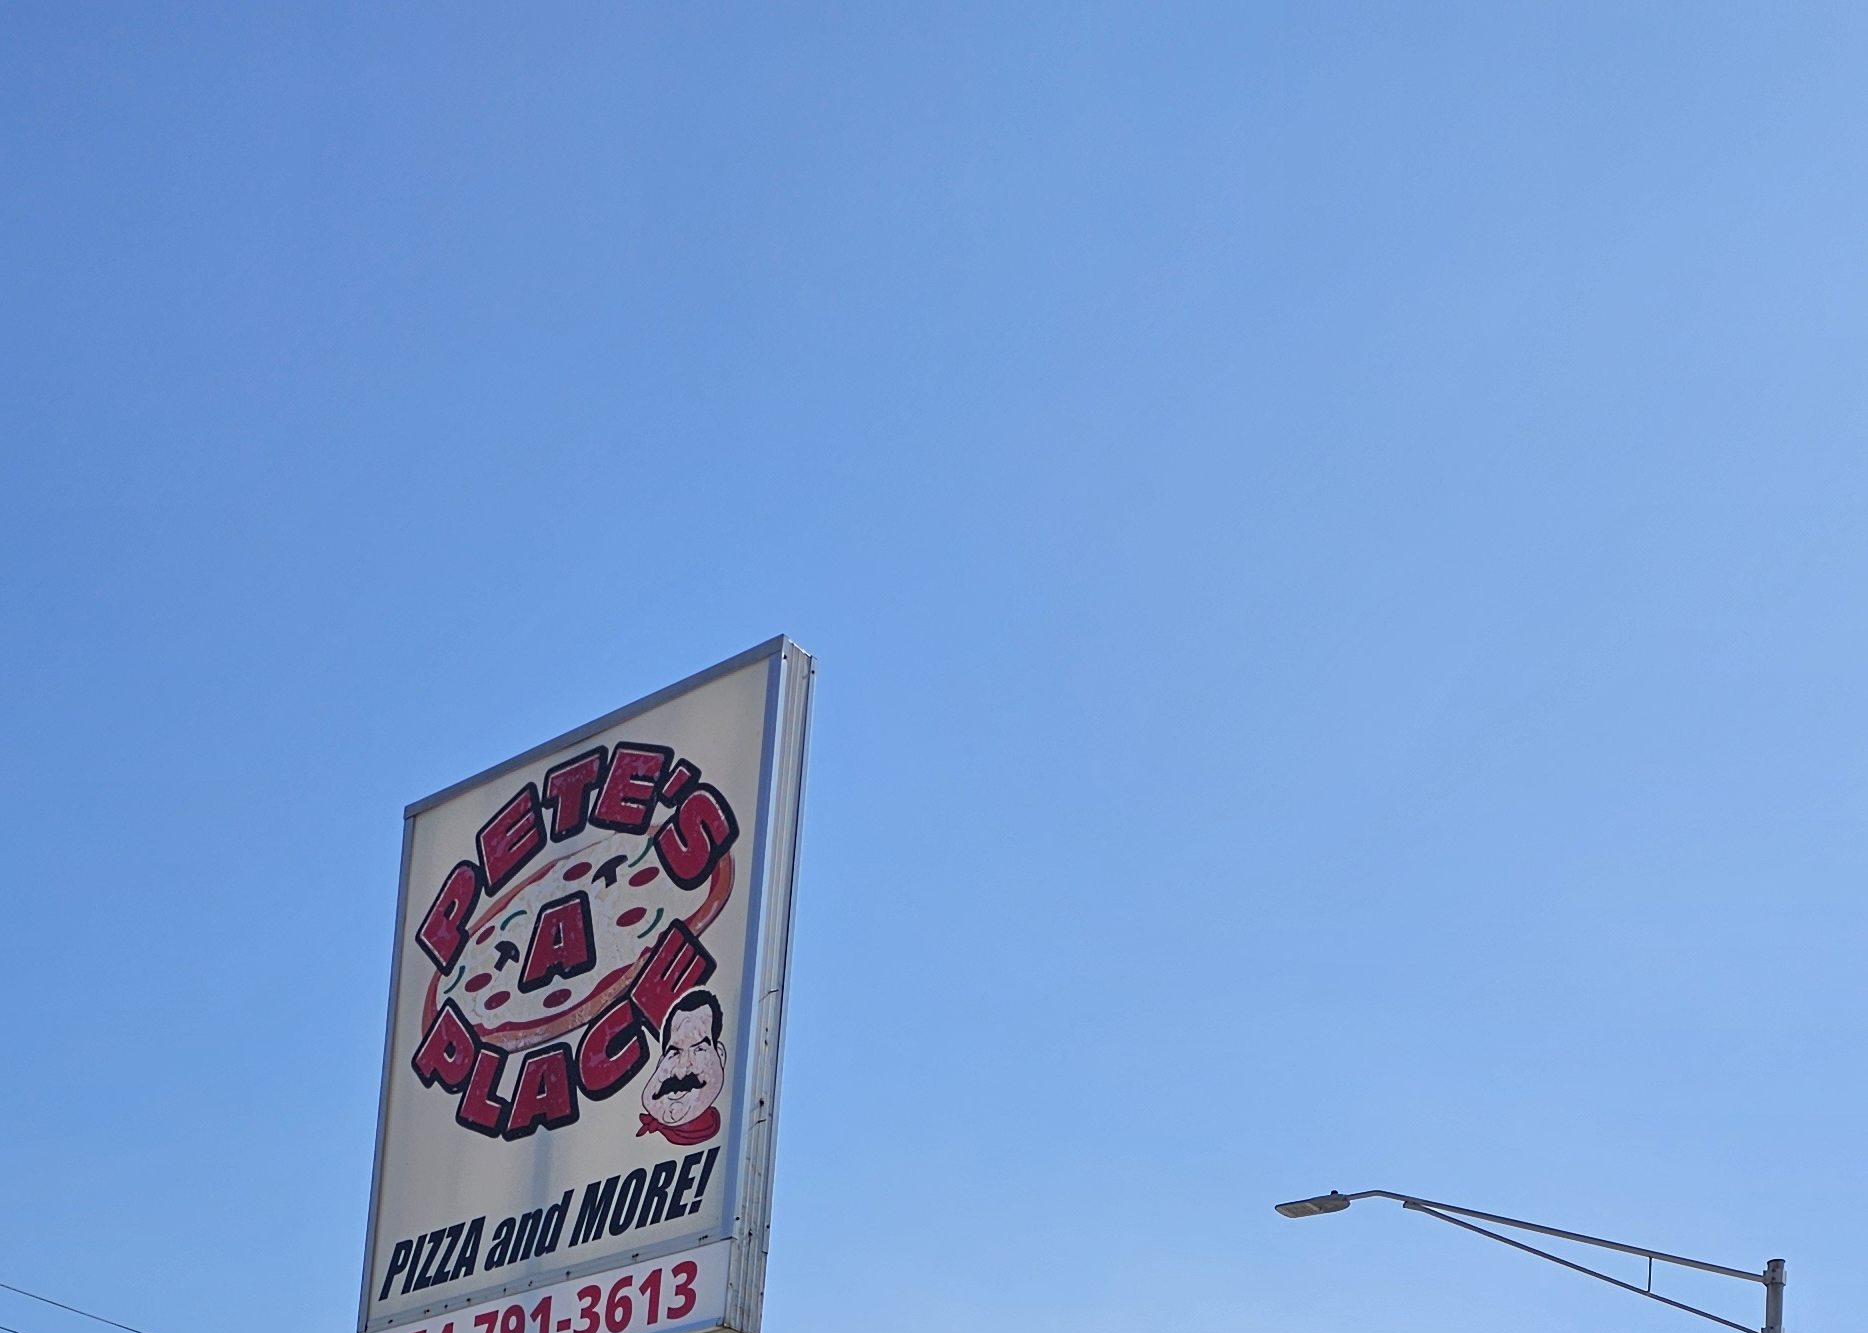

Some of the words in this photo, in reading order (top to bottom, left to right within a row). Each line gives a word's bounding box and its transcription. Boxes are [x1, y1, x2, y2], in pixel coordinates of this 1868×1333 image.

[415, 741, 740, 976] PETE'S
[518, 890, 596, 993] A
[412, 918, 717, 1141] PLACE
[378, 1216, 486, 1301] PIZZA
[484, 1189, 574, 1271] and
[568, 1146, 721, 1247] MORE!
